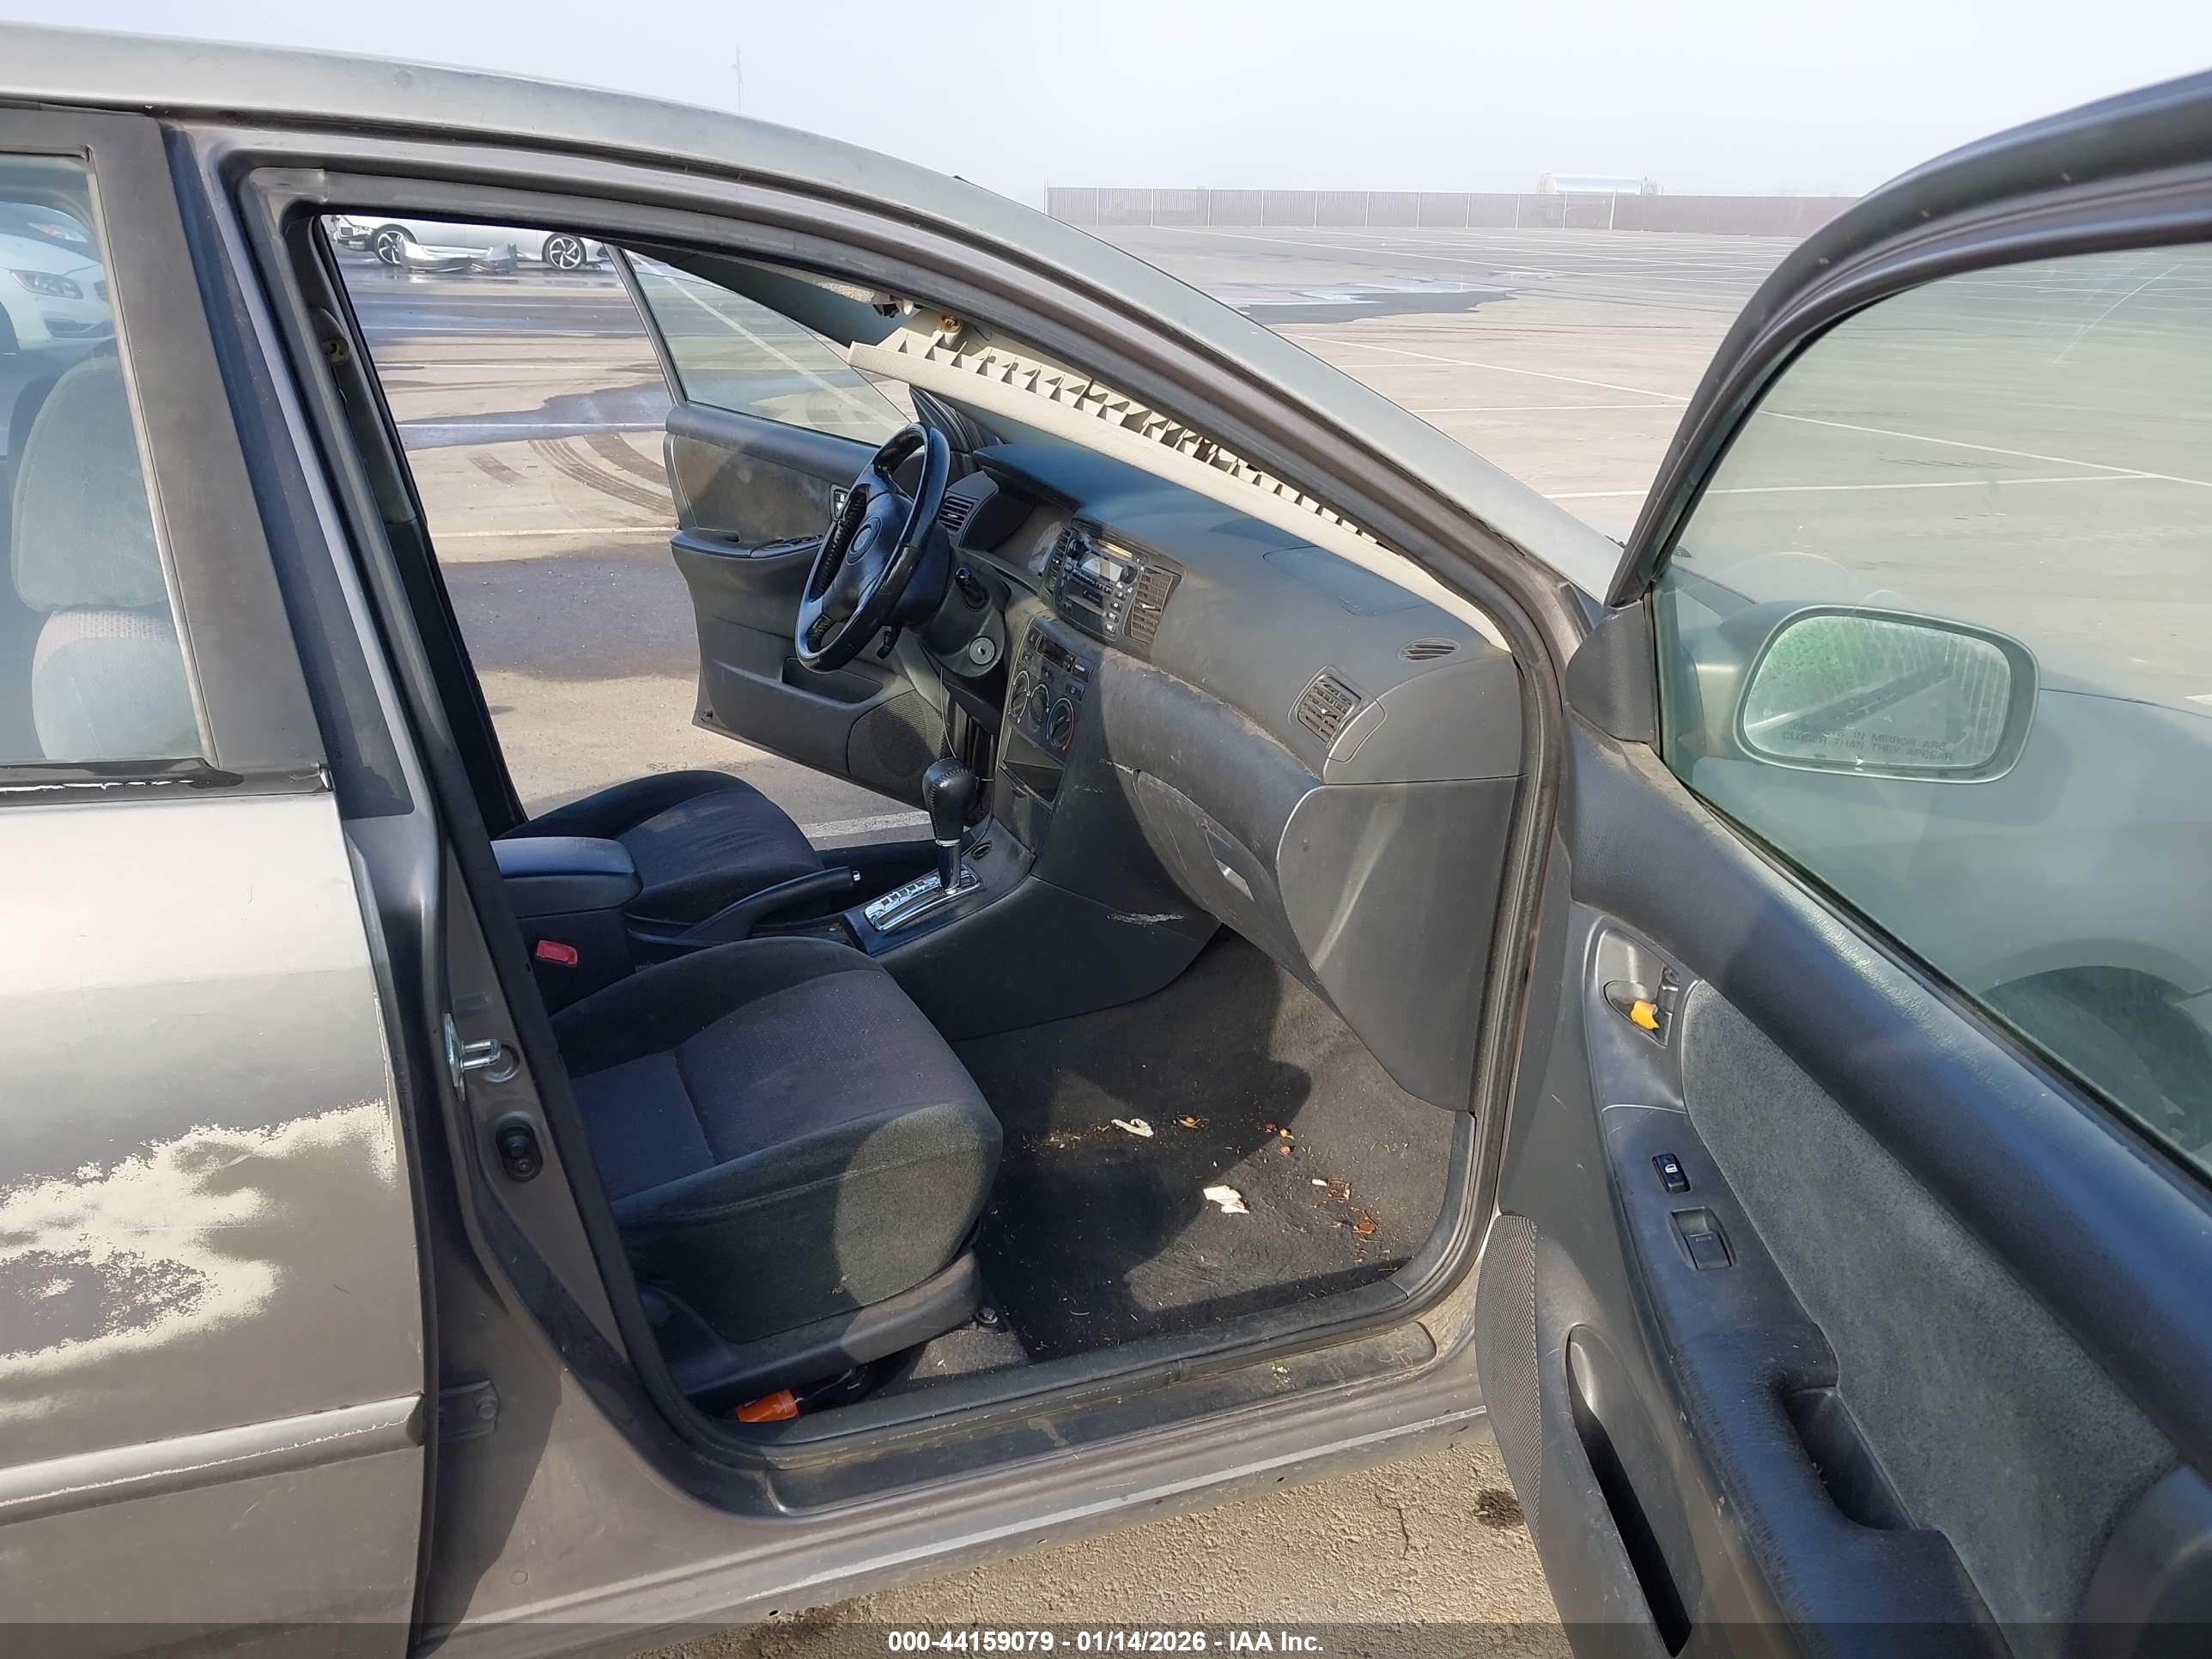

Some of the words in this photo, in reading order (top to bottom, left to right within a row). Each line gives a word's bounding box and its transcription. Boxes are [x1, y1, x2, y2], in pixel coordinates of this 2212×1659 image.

[1833, 739, 1865, 750] THAN
[1872, 743, 1901, 754] THEY
[1907, 748, 1953, 762] APPEAR
[1871, 732, 1917, 746] MIRROR
[1923, 740, 1946, 750] ARE
